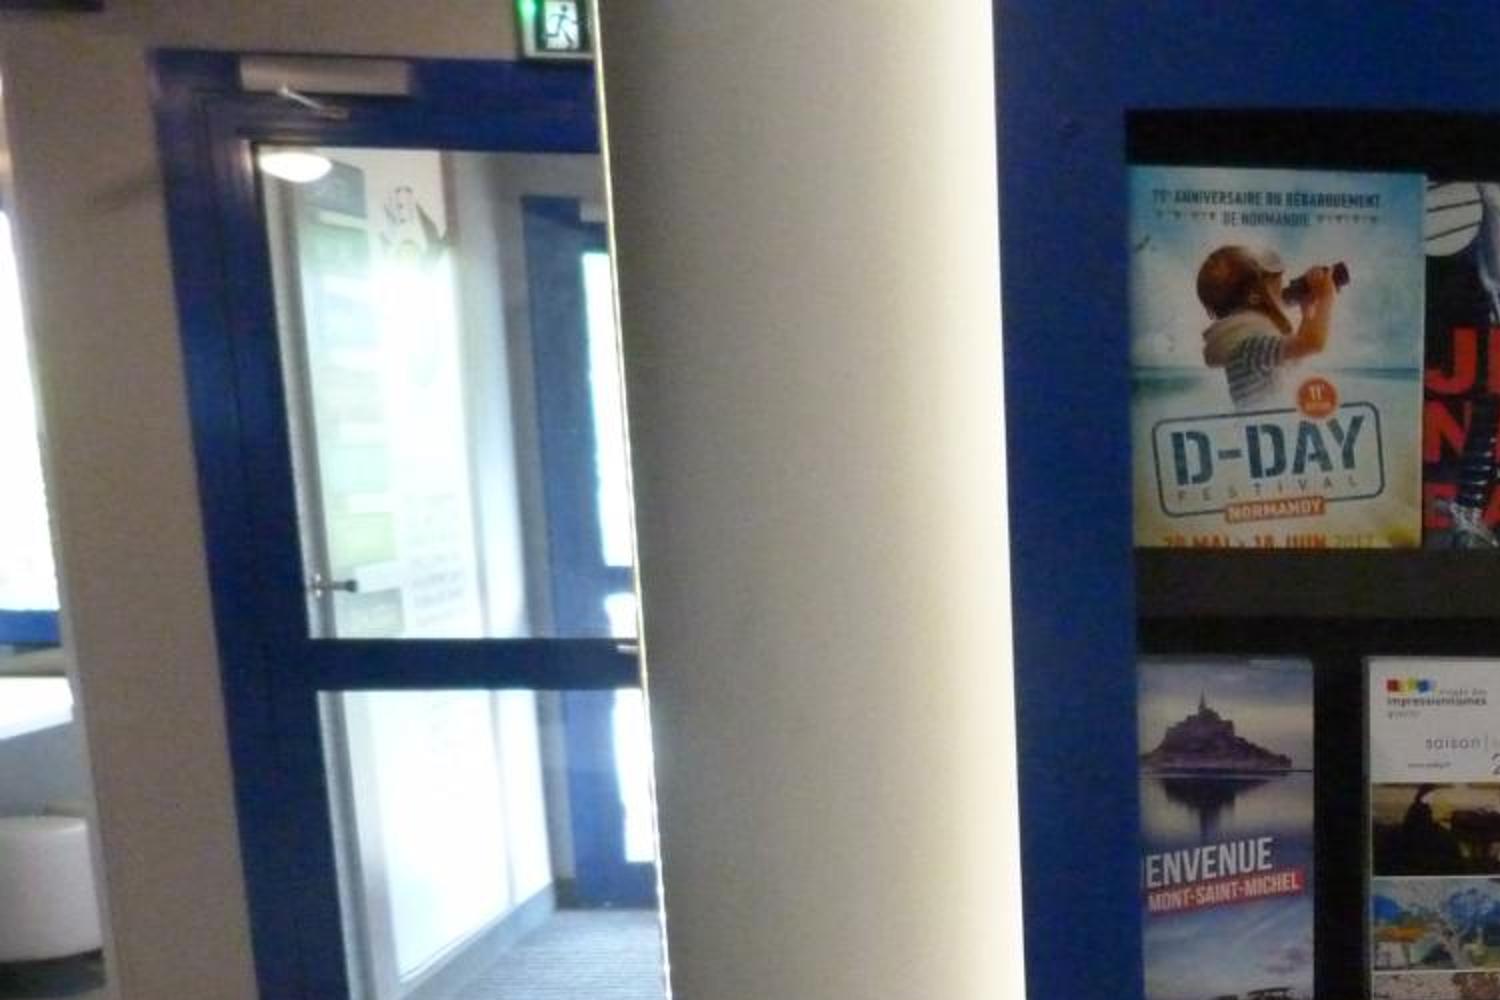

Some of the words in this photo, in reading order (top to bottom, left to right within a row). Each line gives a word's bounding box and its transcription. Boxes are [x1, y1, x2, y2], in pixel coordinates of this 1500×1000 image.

[1175, 190, 1261, 206] ANNIVERSAIRE
[1223, 211, 1237, 227] DE
[1241, 211, 1312, 227] NORMANDIE
[1171, 415, 1365, 486] D-DAY
[1177, 477, 1358, 501] FESTIVAL
[1228, 498, 1322, 519] NORMANDY
[1425, 735, 1481, 750] saison
[1145, 837, 1274, 888] ENVENUE
[1148, 871, 1302, 913] MONT-SAINT-MICHEL
